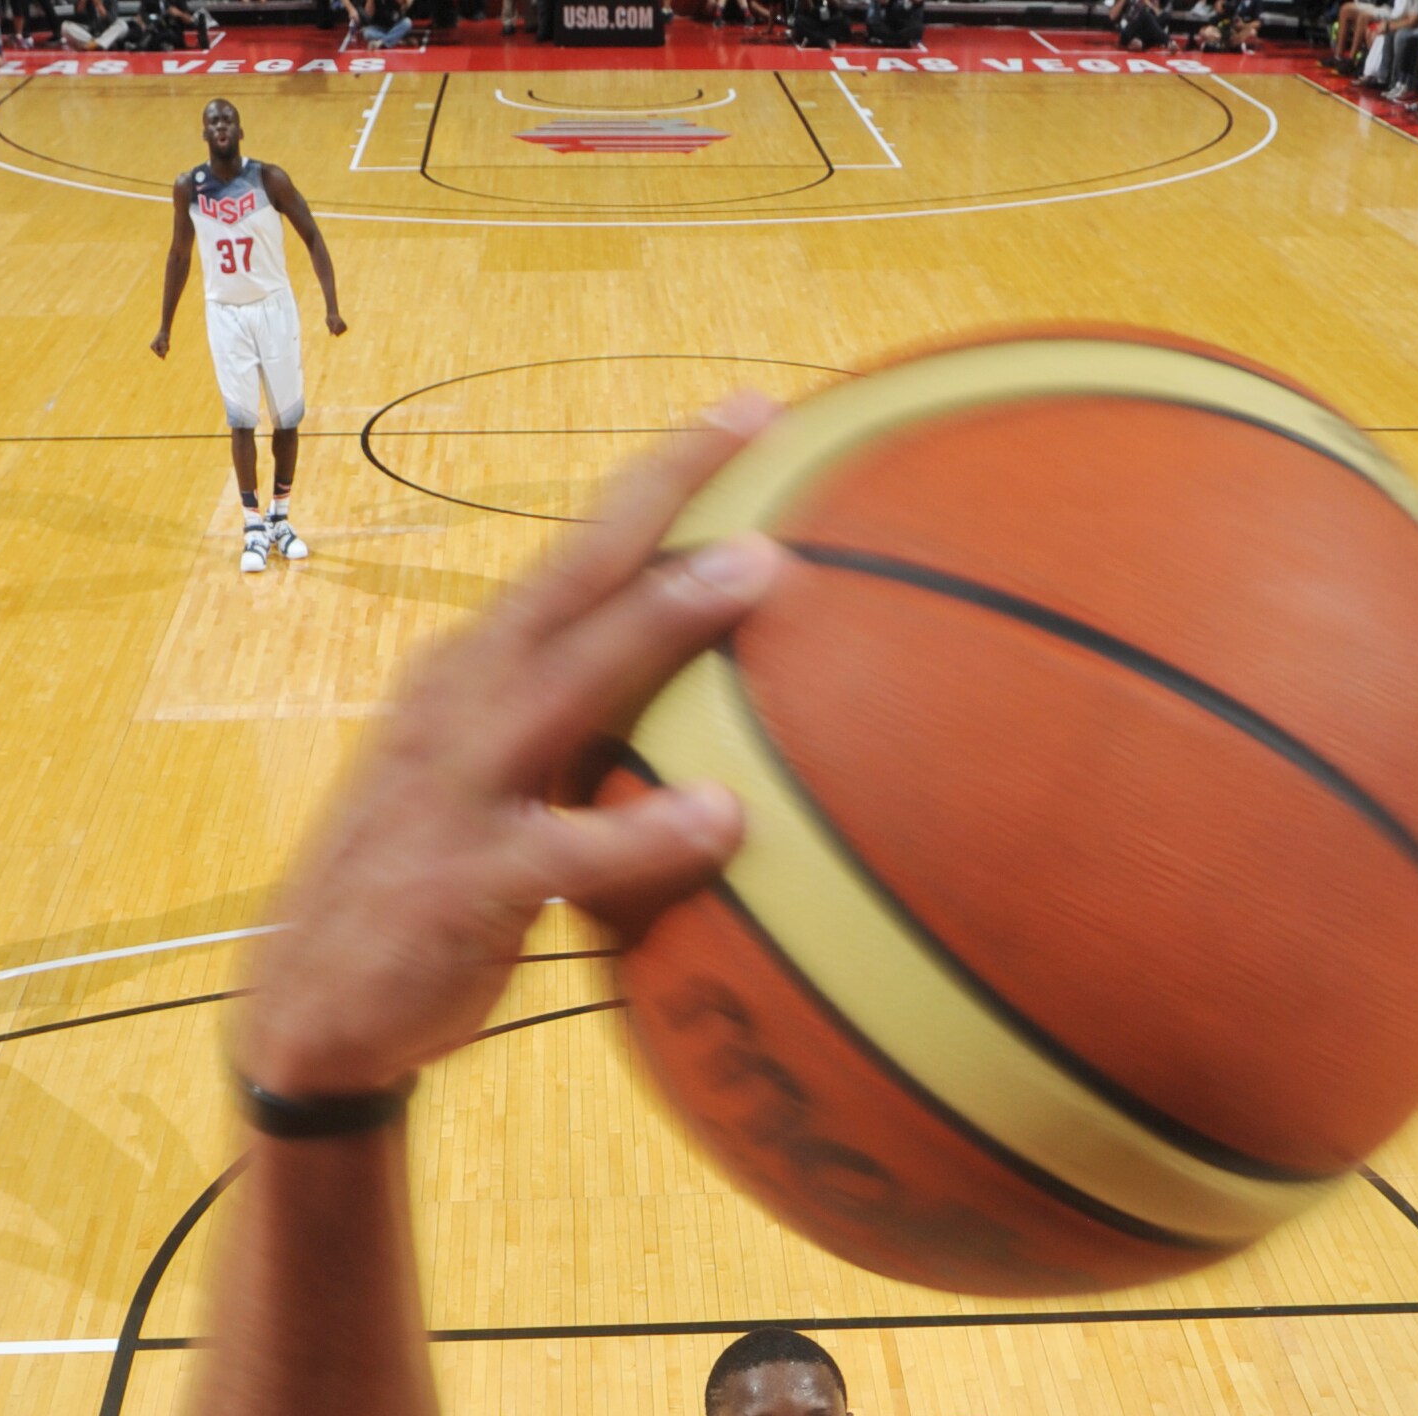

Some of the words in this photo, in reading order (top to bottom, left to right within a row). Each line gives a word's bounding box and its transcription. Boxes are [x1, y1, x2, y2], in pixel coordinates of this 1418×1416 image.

[563, 5, 653, 29] USAB.COM
[162, 58, 386, 75] VEGAS
[831, 57, 958, 73] LAS
[982, 57, 1212, 74] VEGAS
[197, 191, 256, 226] USA
[216, 237, 253, 275] 37
